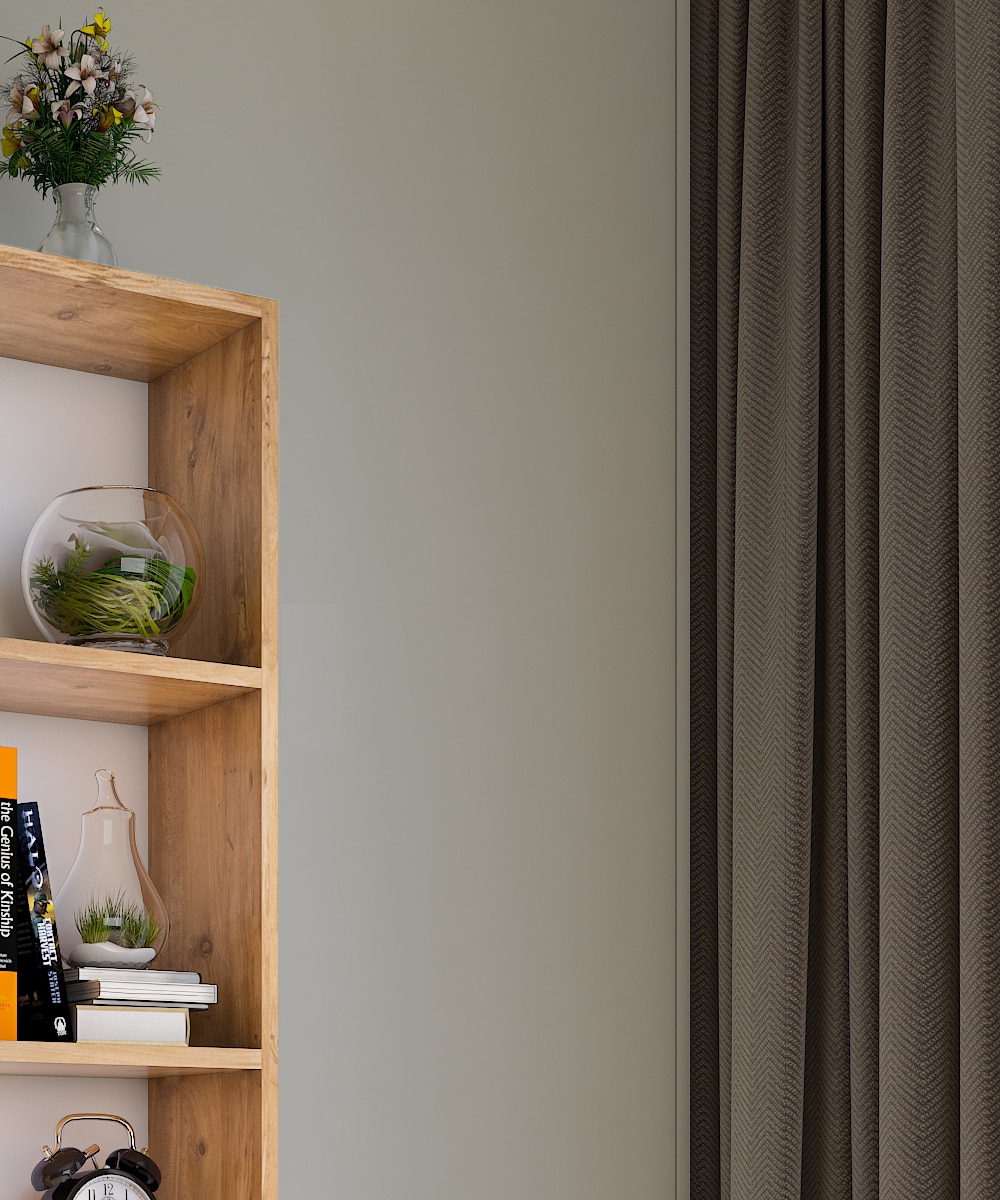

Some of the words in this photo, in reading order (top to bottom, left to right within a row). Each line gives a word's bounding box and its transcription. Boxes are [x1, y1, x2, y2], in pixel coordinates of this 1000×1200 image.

[0, 802, 14, 822] the
[0, 826, 14, 870] Genius
[21, 809, 44, 891] HALO
[0, 873, 14, 888] of
[37, 922, 52, 967] HARVEST
[103, 1183, 114, 1196] 12
